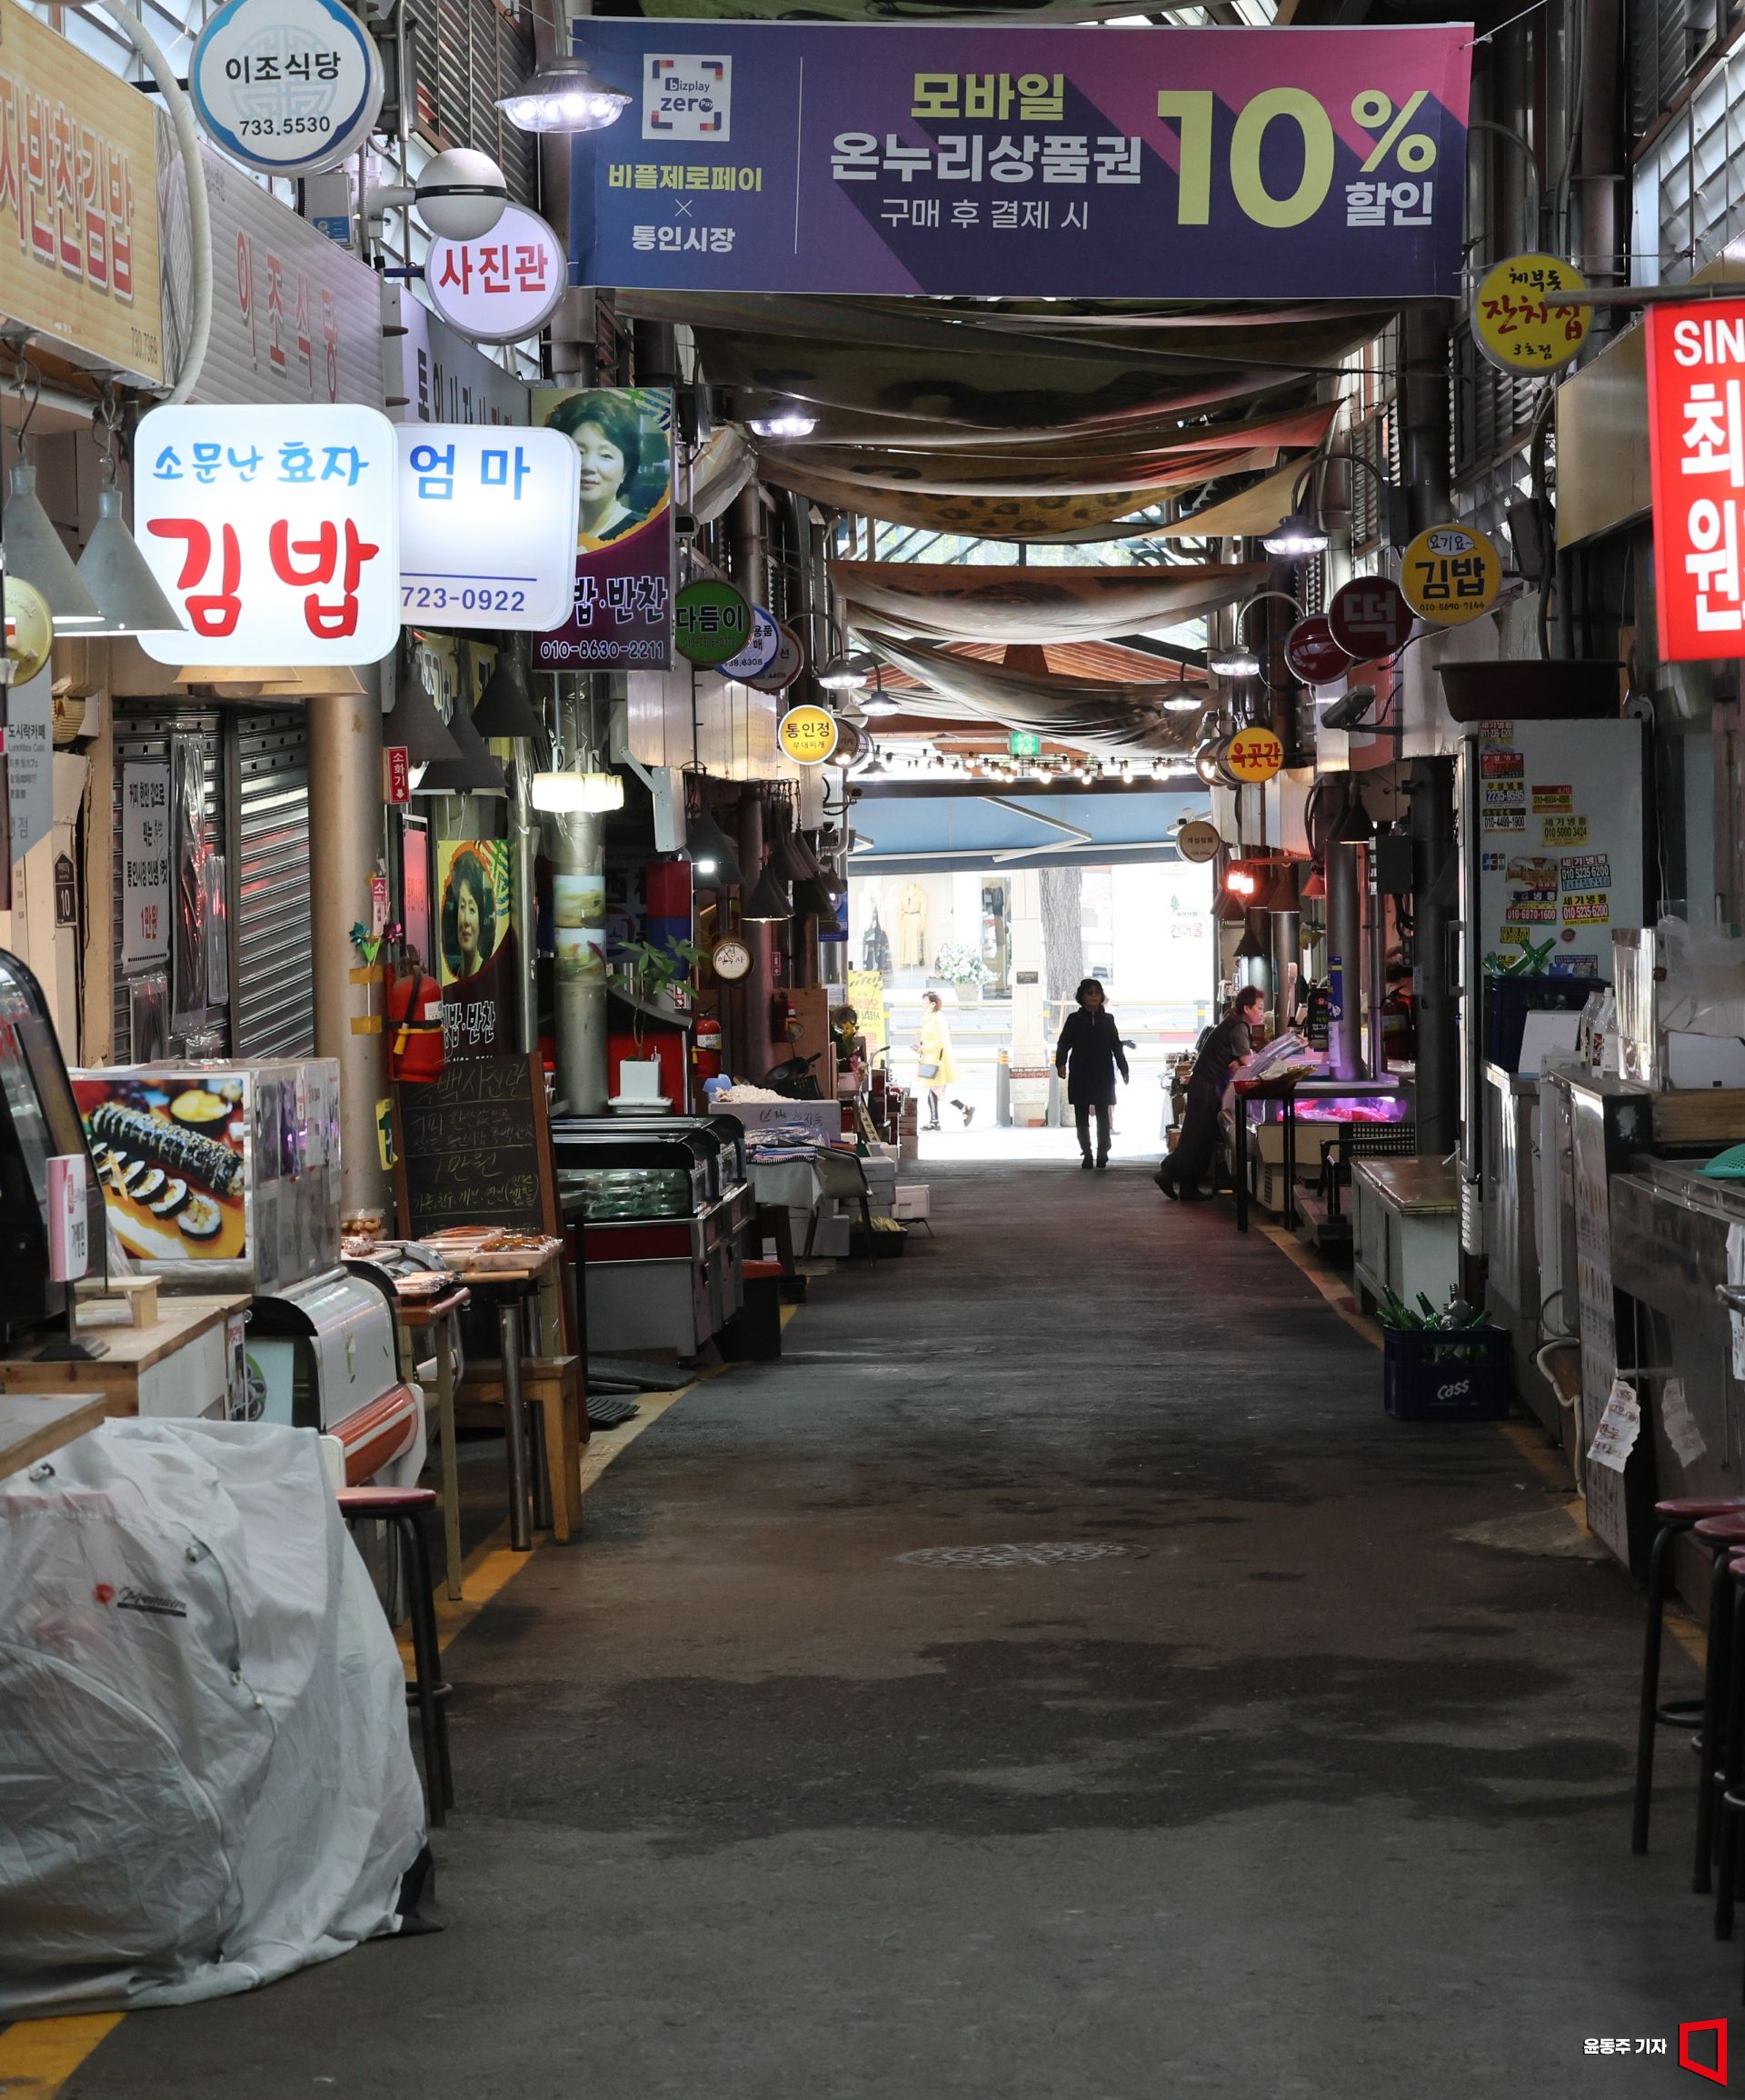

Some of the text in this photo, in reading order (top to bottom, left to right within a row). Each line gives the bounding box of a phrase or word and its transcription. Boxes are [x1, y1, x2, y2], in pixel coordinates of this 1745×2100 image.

[225, 51, 342, 84] 이조식당
[665, 77, 710, 93] bizplay
[911, 72, 1065, 122] 모바일
[239, 115, 331, 136] 733.5530
[830, 132, 1142, 185] 온누리상품권
[1157, 86, 1437, 229] 10%
[608, 164, 763, 194] 비플제로페이
[881, 198, 1089, 230] 구매 후 결제 시
[1345, 181, 1433, 227] 할인
[631, 225, 736, 254] 통인시장
[438, 242, 549, 296] 사진관
[1481, 295, 1583, 341] 잔치집
[153, 441, 370, 488] 소문난 효자
[409, 443, 531, 501] 엄마
[145, 516, 380, 640] 김밥
[1415, 556, 1486, 600] 김밥
[400, 585, 525, 614] 723-0922
[675, 605, 743, 634] 다듬이
[753, 625, 773, 637] 용품
[1343, 590, 1397, 645] 떡
[540, 640, 664, 660] 010-8630-2211
[8, 724, 45, 739] 도시락카페
[785, 722, 830, 738] 통인정
[793, 740, 825, 750] 부대찌개
[392, 753, 405, 787] 소화기
[127, 860, 147, 888] 통인시장
[61, 889, 71, 917] 10
[1563, 894, 1607, 905] 세기냉동
[141, 905, 158, 940] 1만원
[434, 1151, 505, 1184] 1만원
